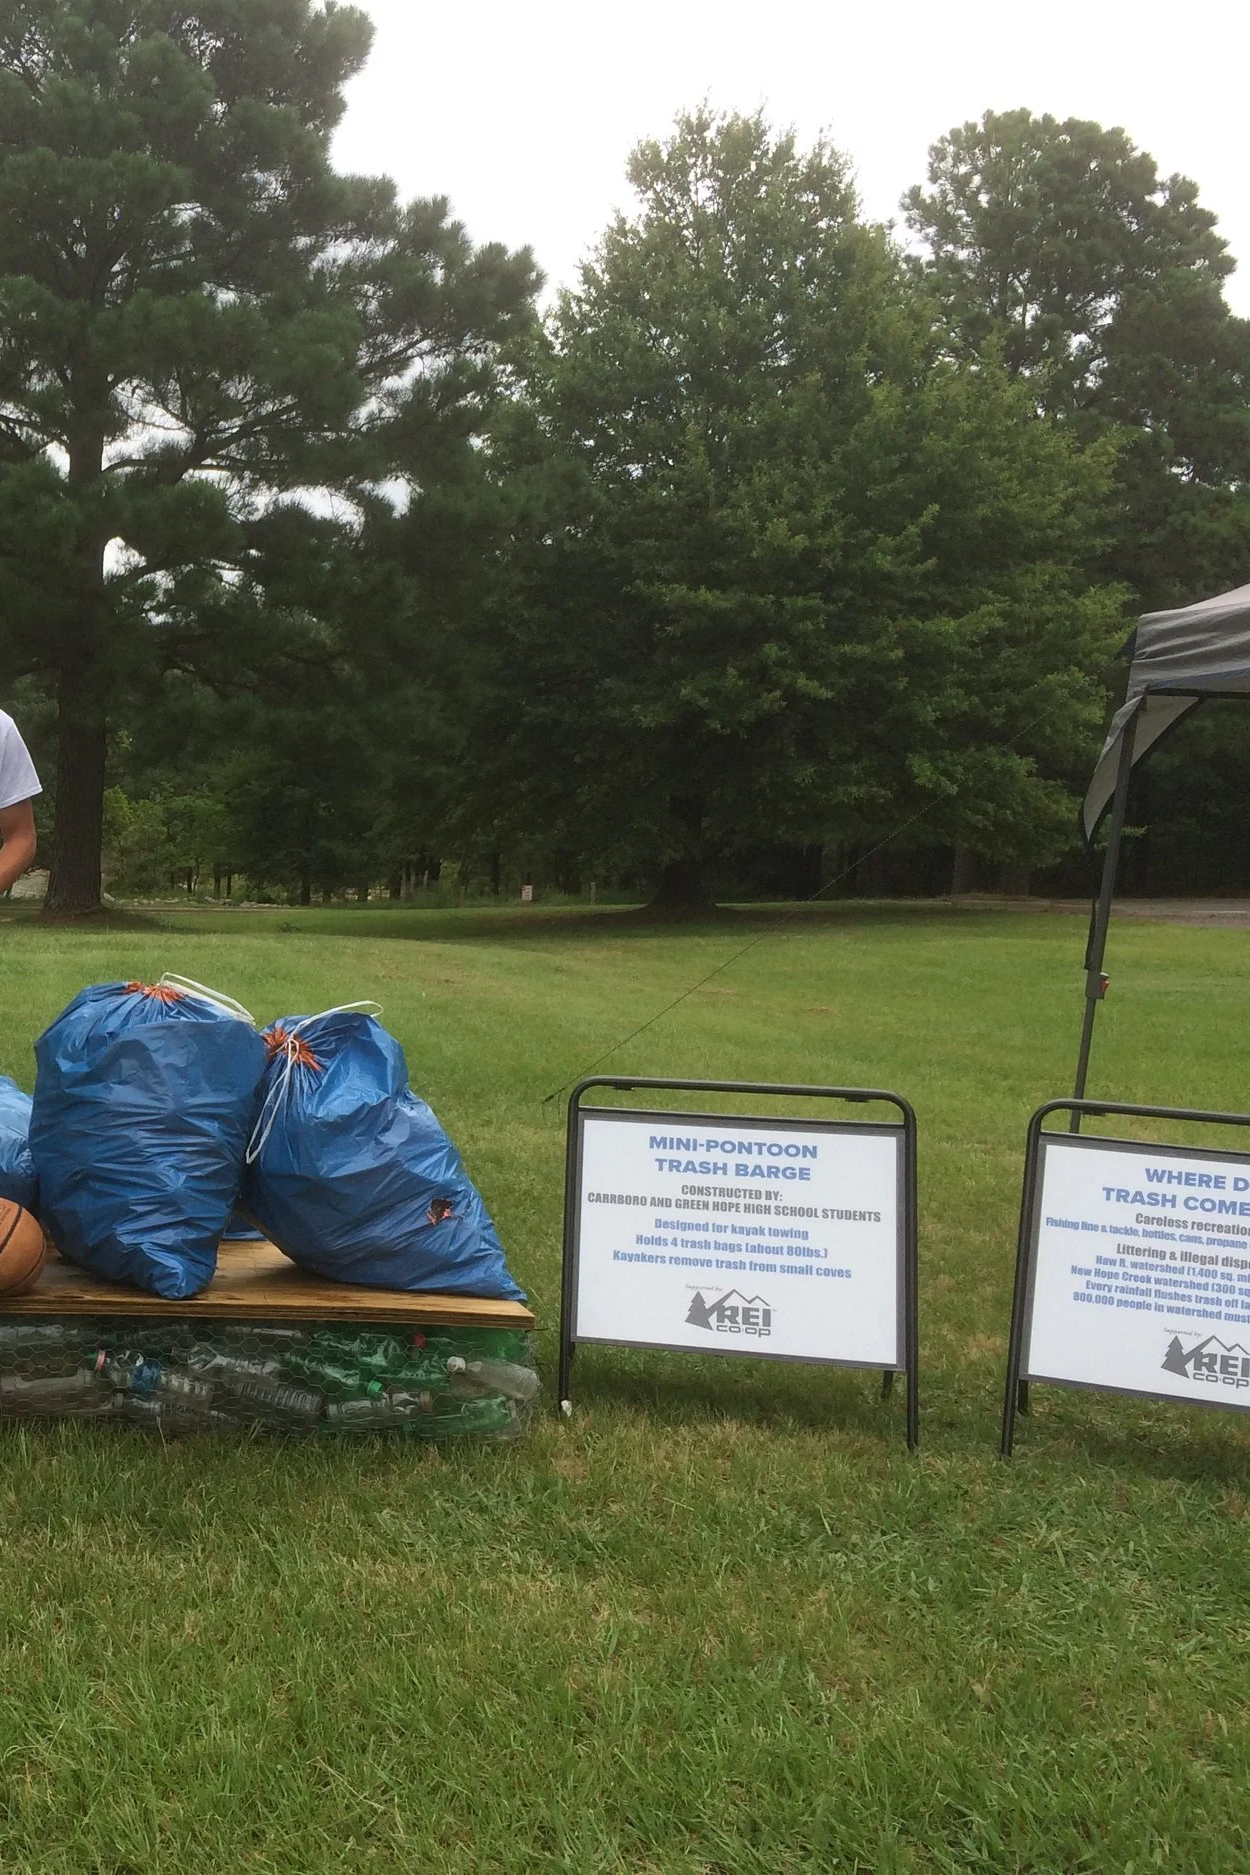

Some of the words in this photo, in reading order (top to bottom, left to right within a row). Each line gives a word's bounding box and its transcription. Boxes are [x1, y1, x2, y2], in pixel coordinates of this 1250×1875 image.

[649, 1135, 818, 1159] MINI-PONTOON
[654, 1157, 728, 1176] TRASH
[734, 1163, 811, 1181] BARGE
[1144, 1167, 1226, 1190] WHERE
[1233, 1176, 1250, 1193] D
[681, 1184, 762, 1200] CONSTRUCTED
[764, 1190, 782, 1201] BY:
[1102, 1186, 1177, 1208] TRASH
[587, 1192, 647, 1207] CARRBORO
[649, 1196, 672, 1208] AND
[674, 1198, 709, 1211] GREEN
[712, 1200, 741, 1213] HOPE
[743, 1202, 771, 1215] HIGH
[773, 1204, 819, 1218] SCHOOL
[821, 1208, 881, 1223] STUDENTS
[654, 1218, 709, 1232] Designed
[711, 1222, 729, 1233] for
[730, 1223, 766, 1236] kayak
[768, 1227, 809, 1241] towing
[1045, 1216, 1080, 1231] Fishing
[1080, 1220, 1100, 1232] line
[1100, 1224, 1108, 1233] &
[1108, 1224, 1140, 1237] tackle,
[1141, 1227, 1177, 1242] bottles,
[1205, 1237, 1247, 1249] propane
[1135, 1212, 1188, 1229] Careless
[1190, 1220, 1250, 1237] recreatio
[635, 1234, 668, 1247] Holds
[670, 1237, 678, 1247] 4
[680, 1238, 711, 1250] trash
[713, 1240, 743, 1253] bags
[612, 1249, 667, 1264] Kayakers
[668, 1256, 713, 1268] remove
[715, 1258, 746, 1270] trash
[748, 1260, 777, 1273] from
[779, 1264, 813, 1276] small
[815, 1267, 852, 1279] coves
[1095, 1255, 1116, 1267] Haw
[1118, 1257, 1127, 1268] R.
[1130, 1261, 1185, 1275] watershed
[1220, 1271, 1236, 1283] sq.
[1237, 1272, 1250, 1284] mi
[1116, 1243, 1166, 1261] Littering
[1169, 1251, 1177, 1261] &
[1180, 1251, 1219, 1266] illegal
[1221, 1256, 1250, 1272] disp
[1070, 1264, 1092, 1276] New
[1093, 1267, 1119, 1280] Hope
[1122, 1271, 1151, 1284] Creek
[1154, 1277, 1209, 1291] watershed
[1085, 1279, 1113, 1293] Every
[1114, 1285, 1152, 1298] rainfall
[1154, 1289, 1192, 1303] flushes
[1194, 1294, 1222, 1307] trash
[1224, 1298, 1238, 1308] off
[1240, 1298, 1250, 1311] la
[716, 1305, 771, 1327] REI
[1116, 1298, 1152, 1311] people
[1154, 1301, 1164, 1313] in
[1166, 1305, 1222, 1320] watershed
[1193, 1352, 1250, 1378] REI
